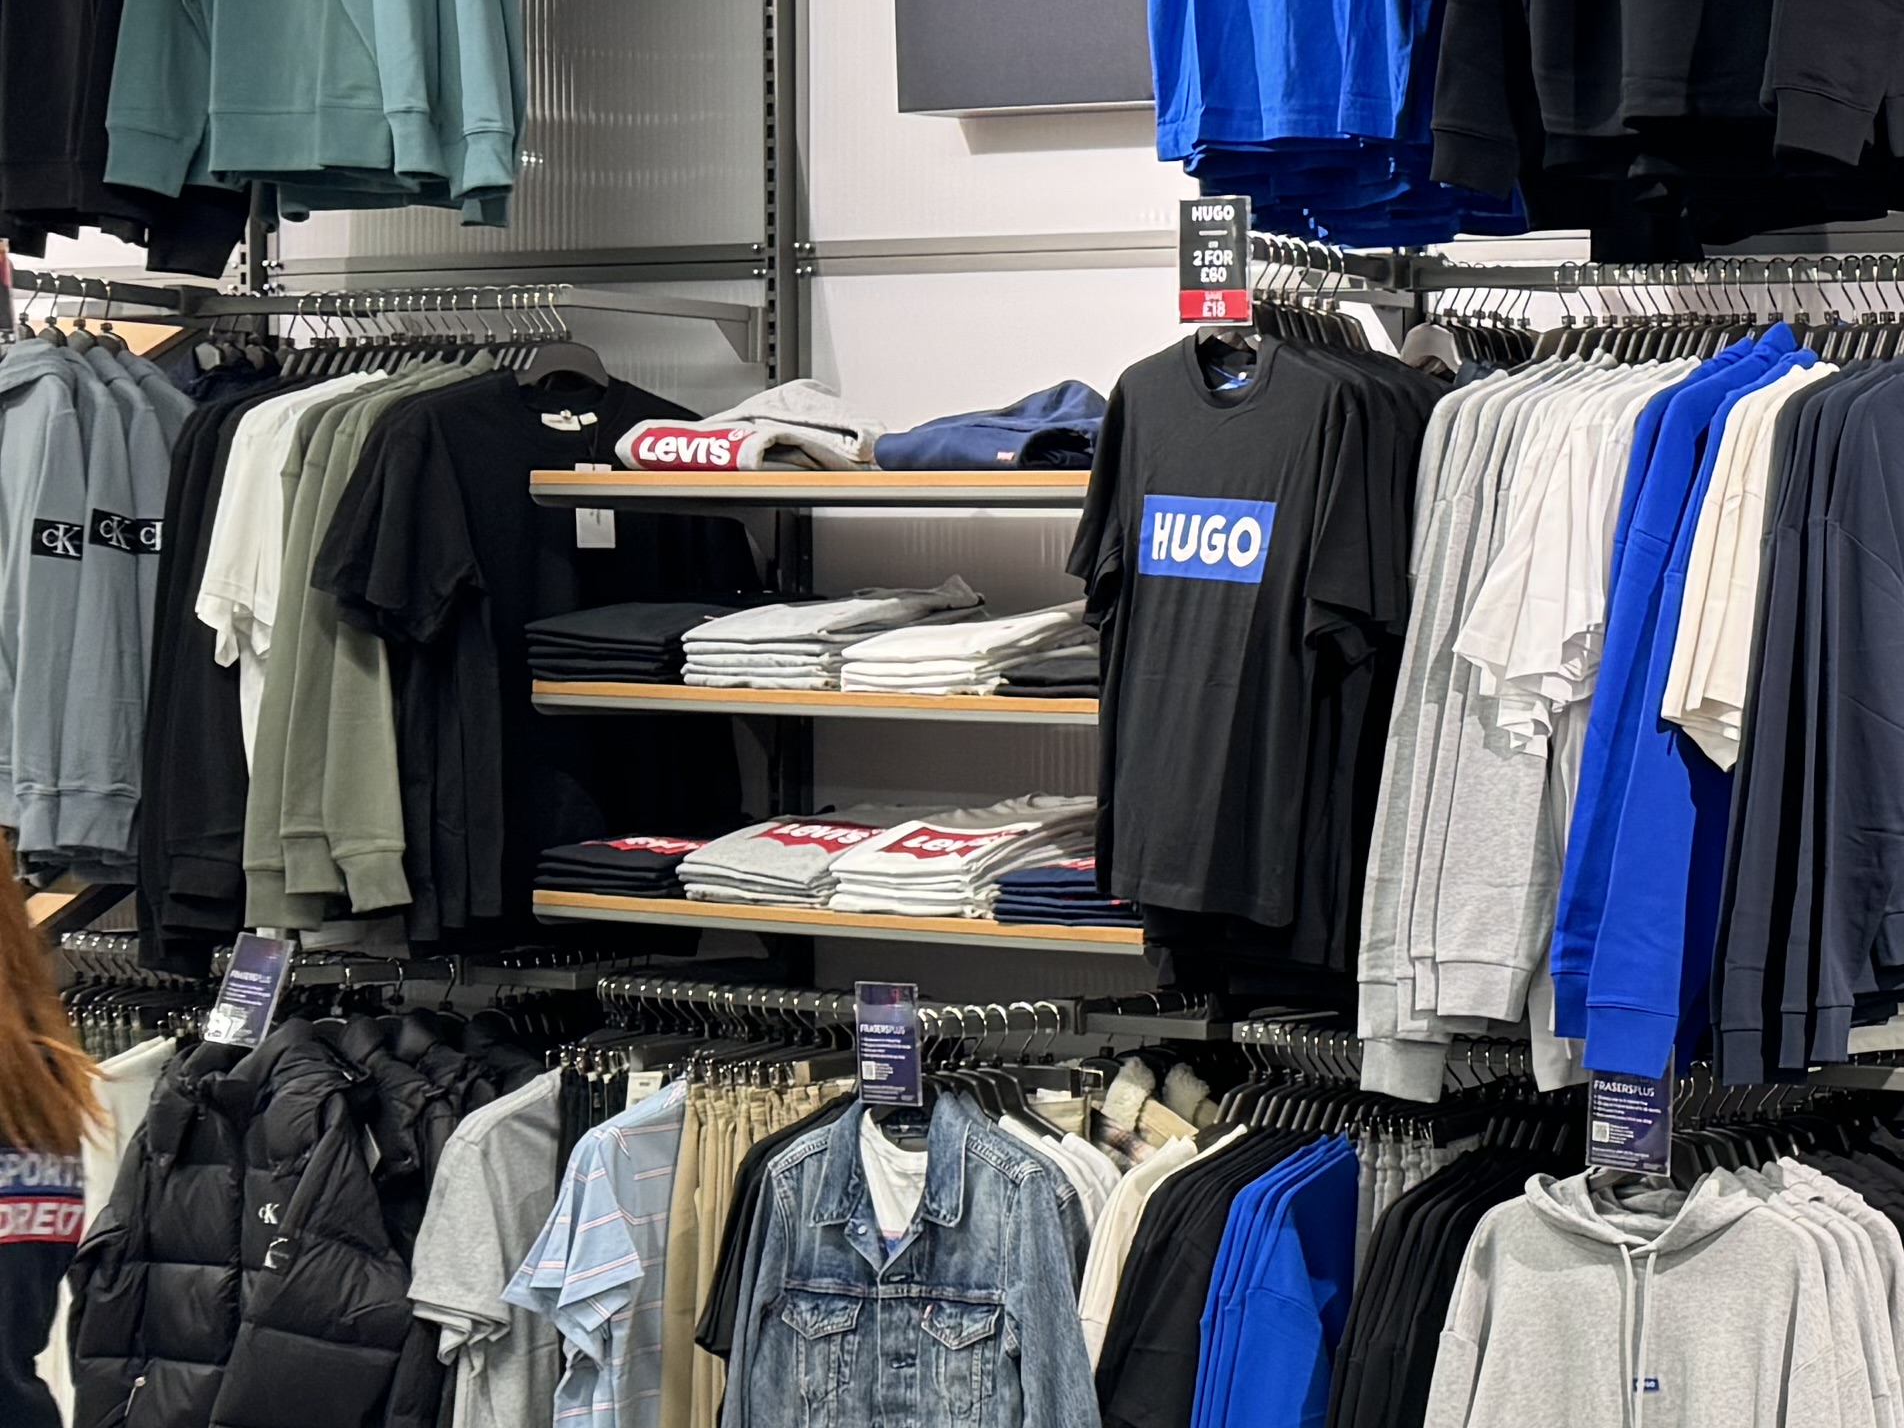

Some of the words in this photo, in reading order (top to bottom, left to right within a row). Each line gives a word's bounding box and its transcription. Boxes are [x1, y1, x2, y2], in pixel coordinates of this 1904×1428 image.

[1191, 204, 1235, 222] HUGO
[1193, 250, 1202, 266] 2
[1204, 249, 1234, 266] FOR
[1200, 266, 1227, 283] £60
[1202, 301, 1226, 318] £18
[1152, 512, 1261, 567] HUGO
[1593, 1079, 1655, 1097] FRASERSPLUS
